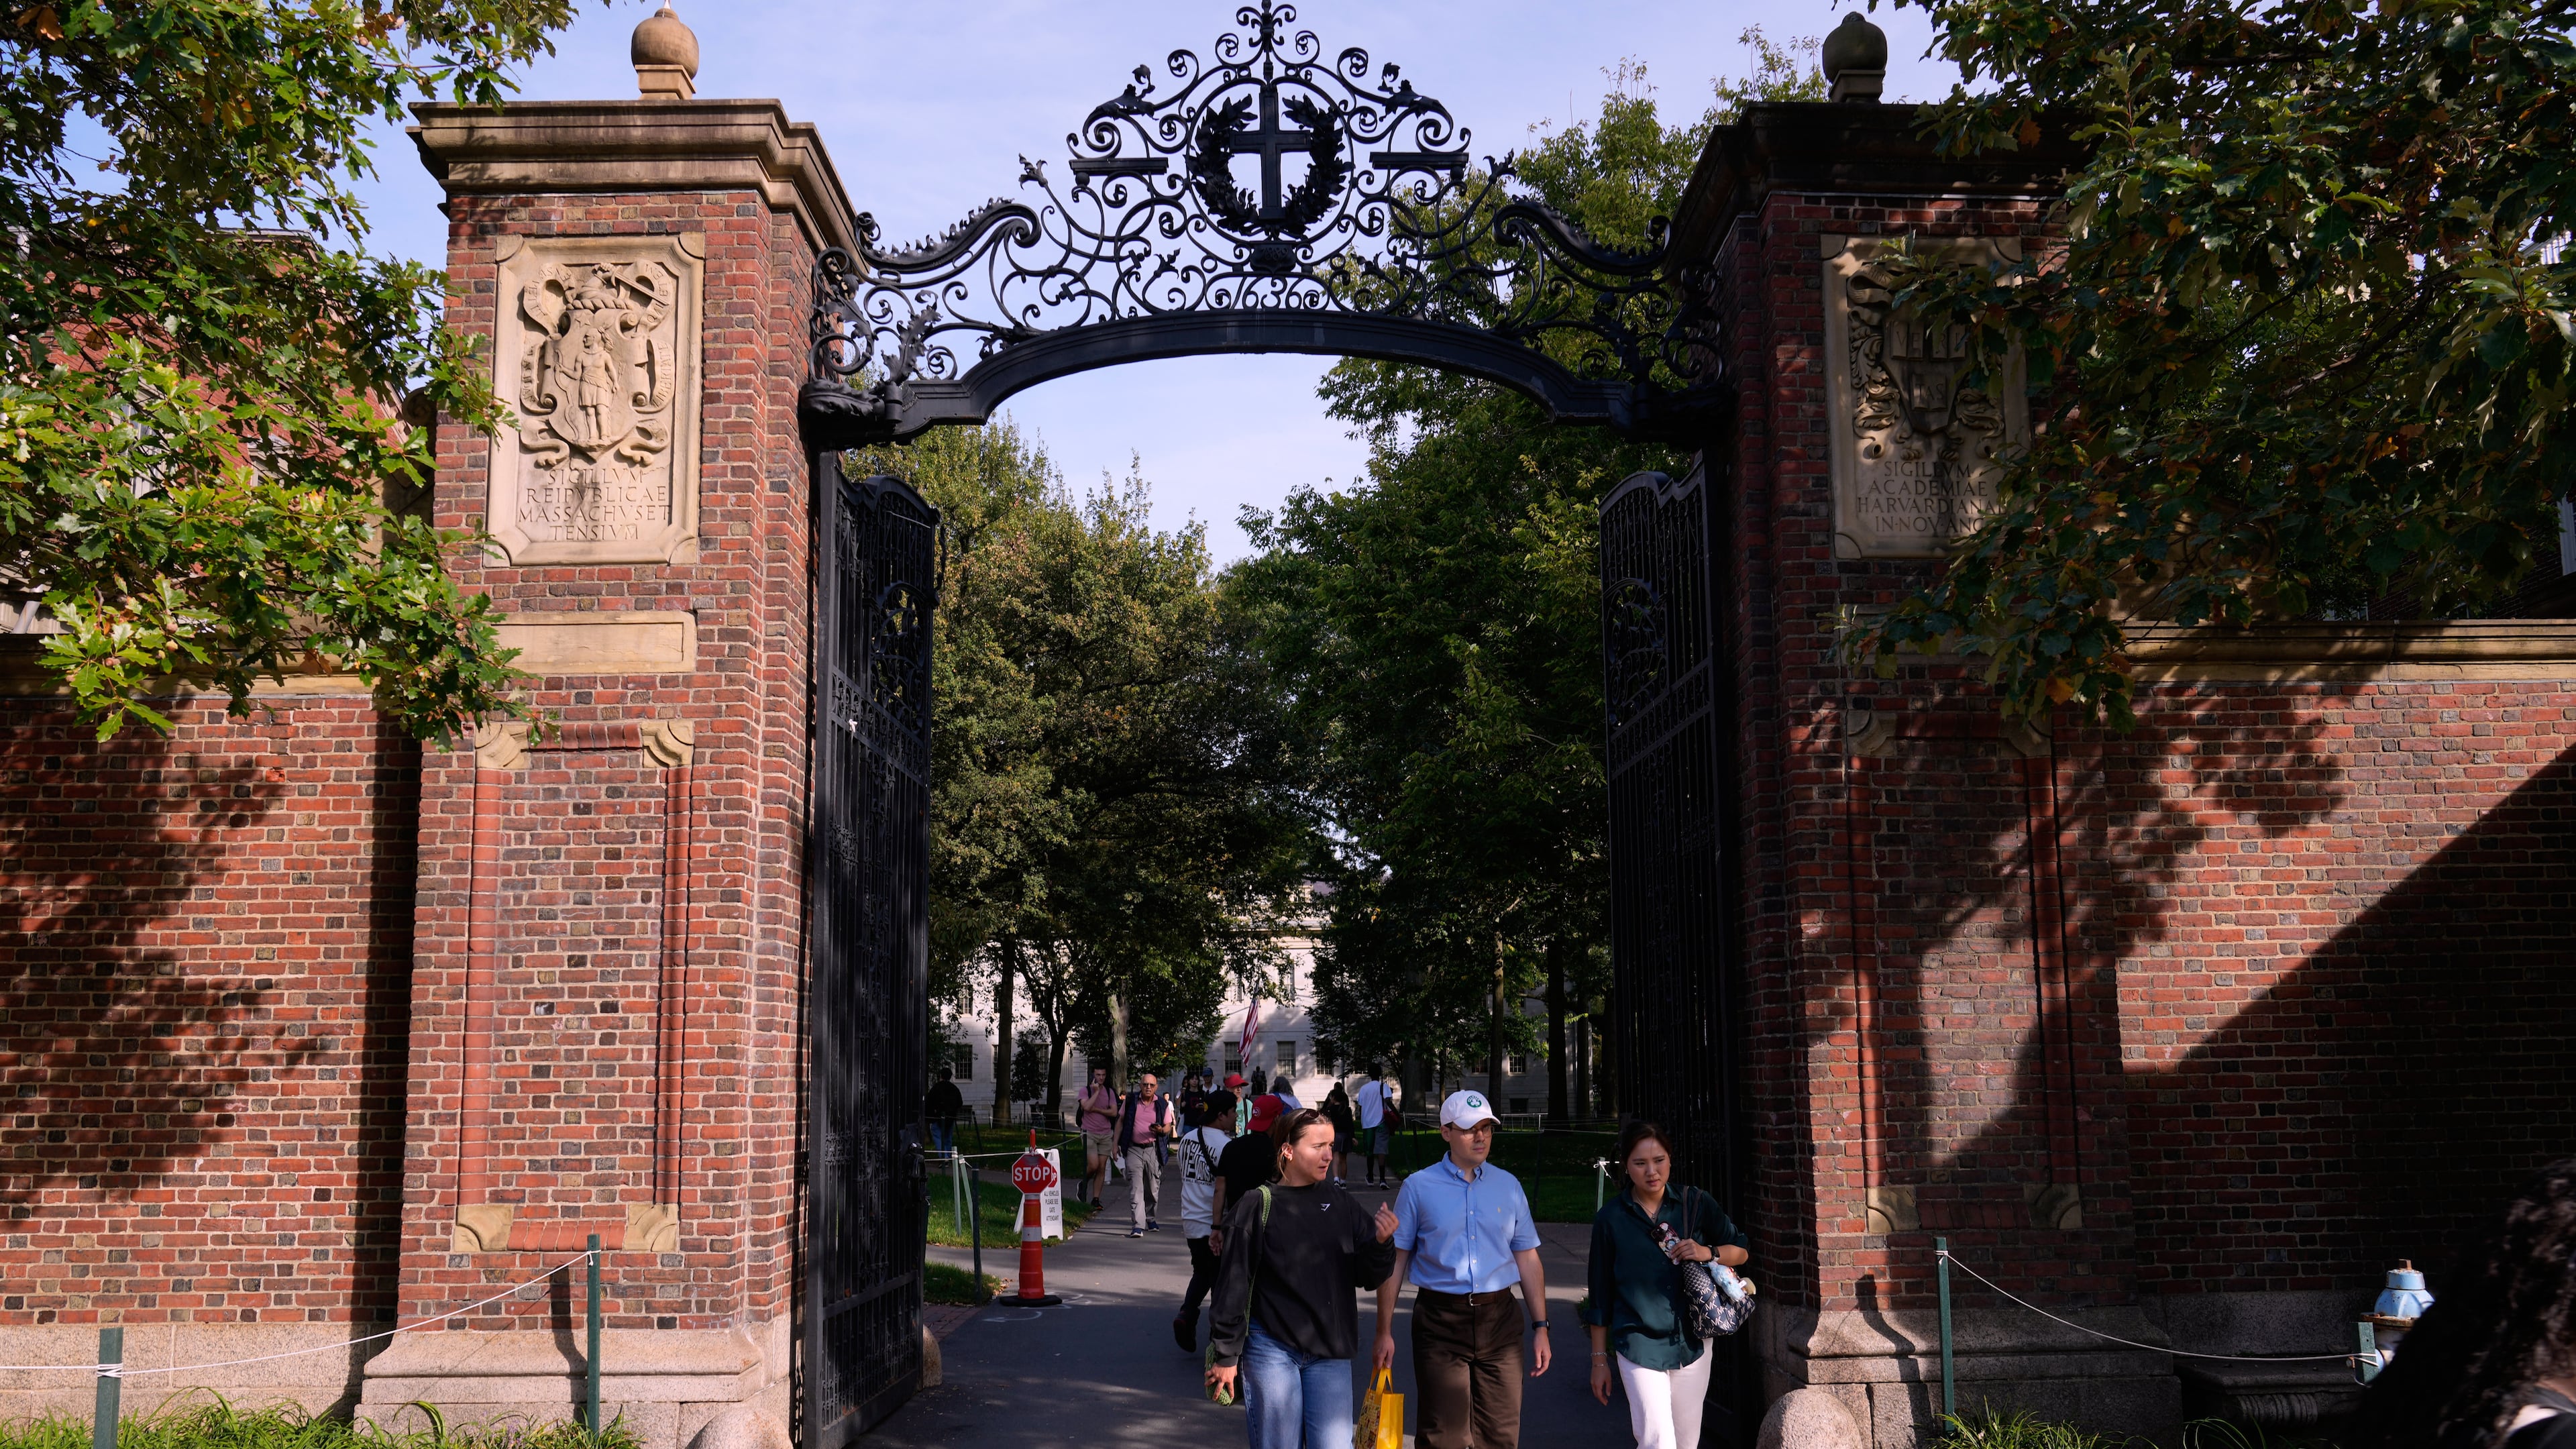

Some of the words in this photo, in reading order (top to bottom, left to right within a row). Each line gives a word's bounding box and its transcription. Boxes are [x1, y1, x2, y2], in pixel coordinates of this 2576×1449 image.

[1230, 276, 1302, 309] 1636
[547, 468, 643, 485] SIGILLVM
[1884, 461, 1971, 478] SIGILLVM
[527, 486, 667, 503] REIPVBLICAE
[1868, 480, 1988, 496] ACADEMIAE
[519, 504, 670, 523] MASSACHVSET
[549, 525, 639, 541] TENSIVM
[1014, 1166, 1051, 1181] STOP
